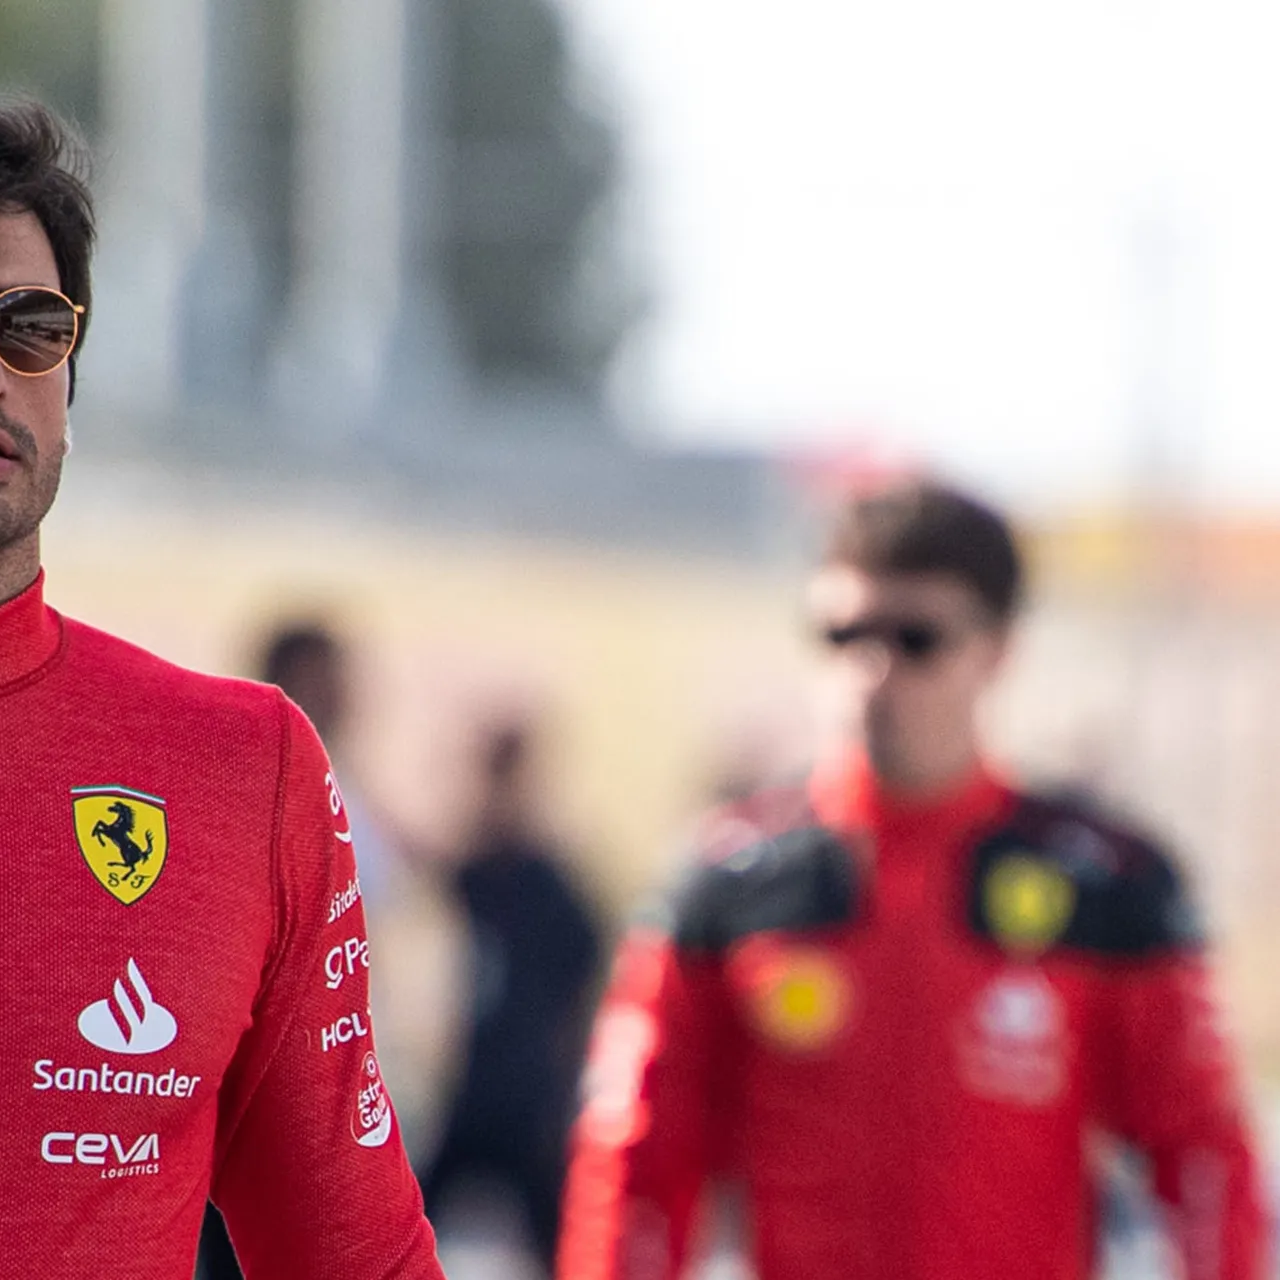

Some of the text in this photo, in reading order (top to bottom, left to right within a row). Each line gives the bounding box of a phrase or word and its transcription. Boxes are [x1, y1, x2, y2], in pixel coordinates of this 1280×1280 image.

[321, 1006, 371, 1052] HCL
[32, 1059, 201, 1098] Santander
[100, 1163, 160, 1180] LOGISTICS
